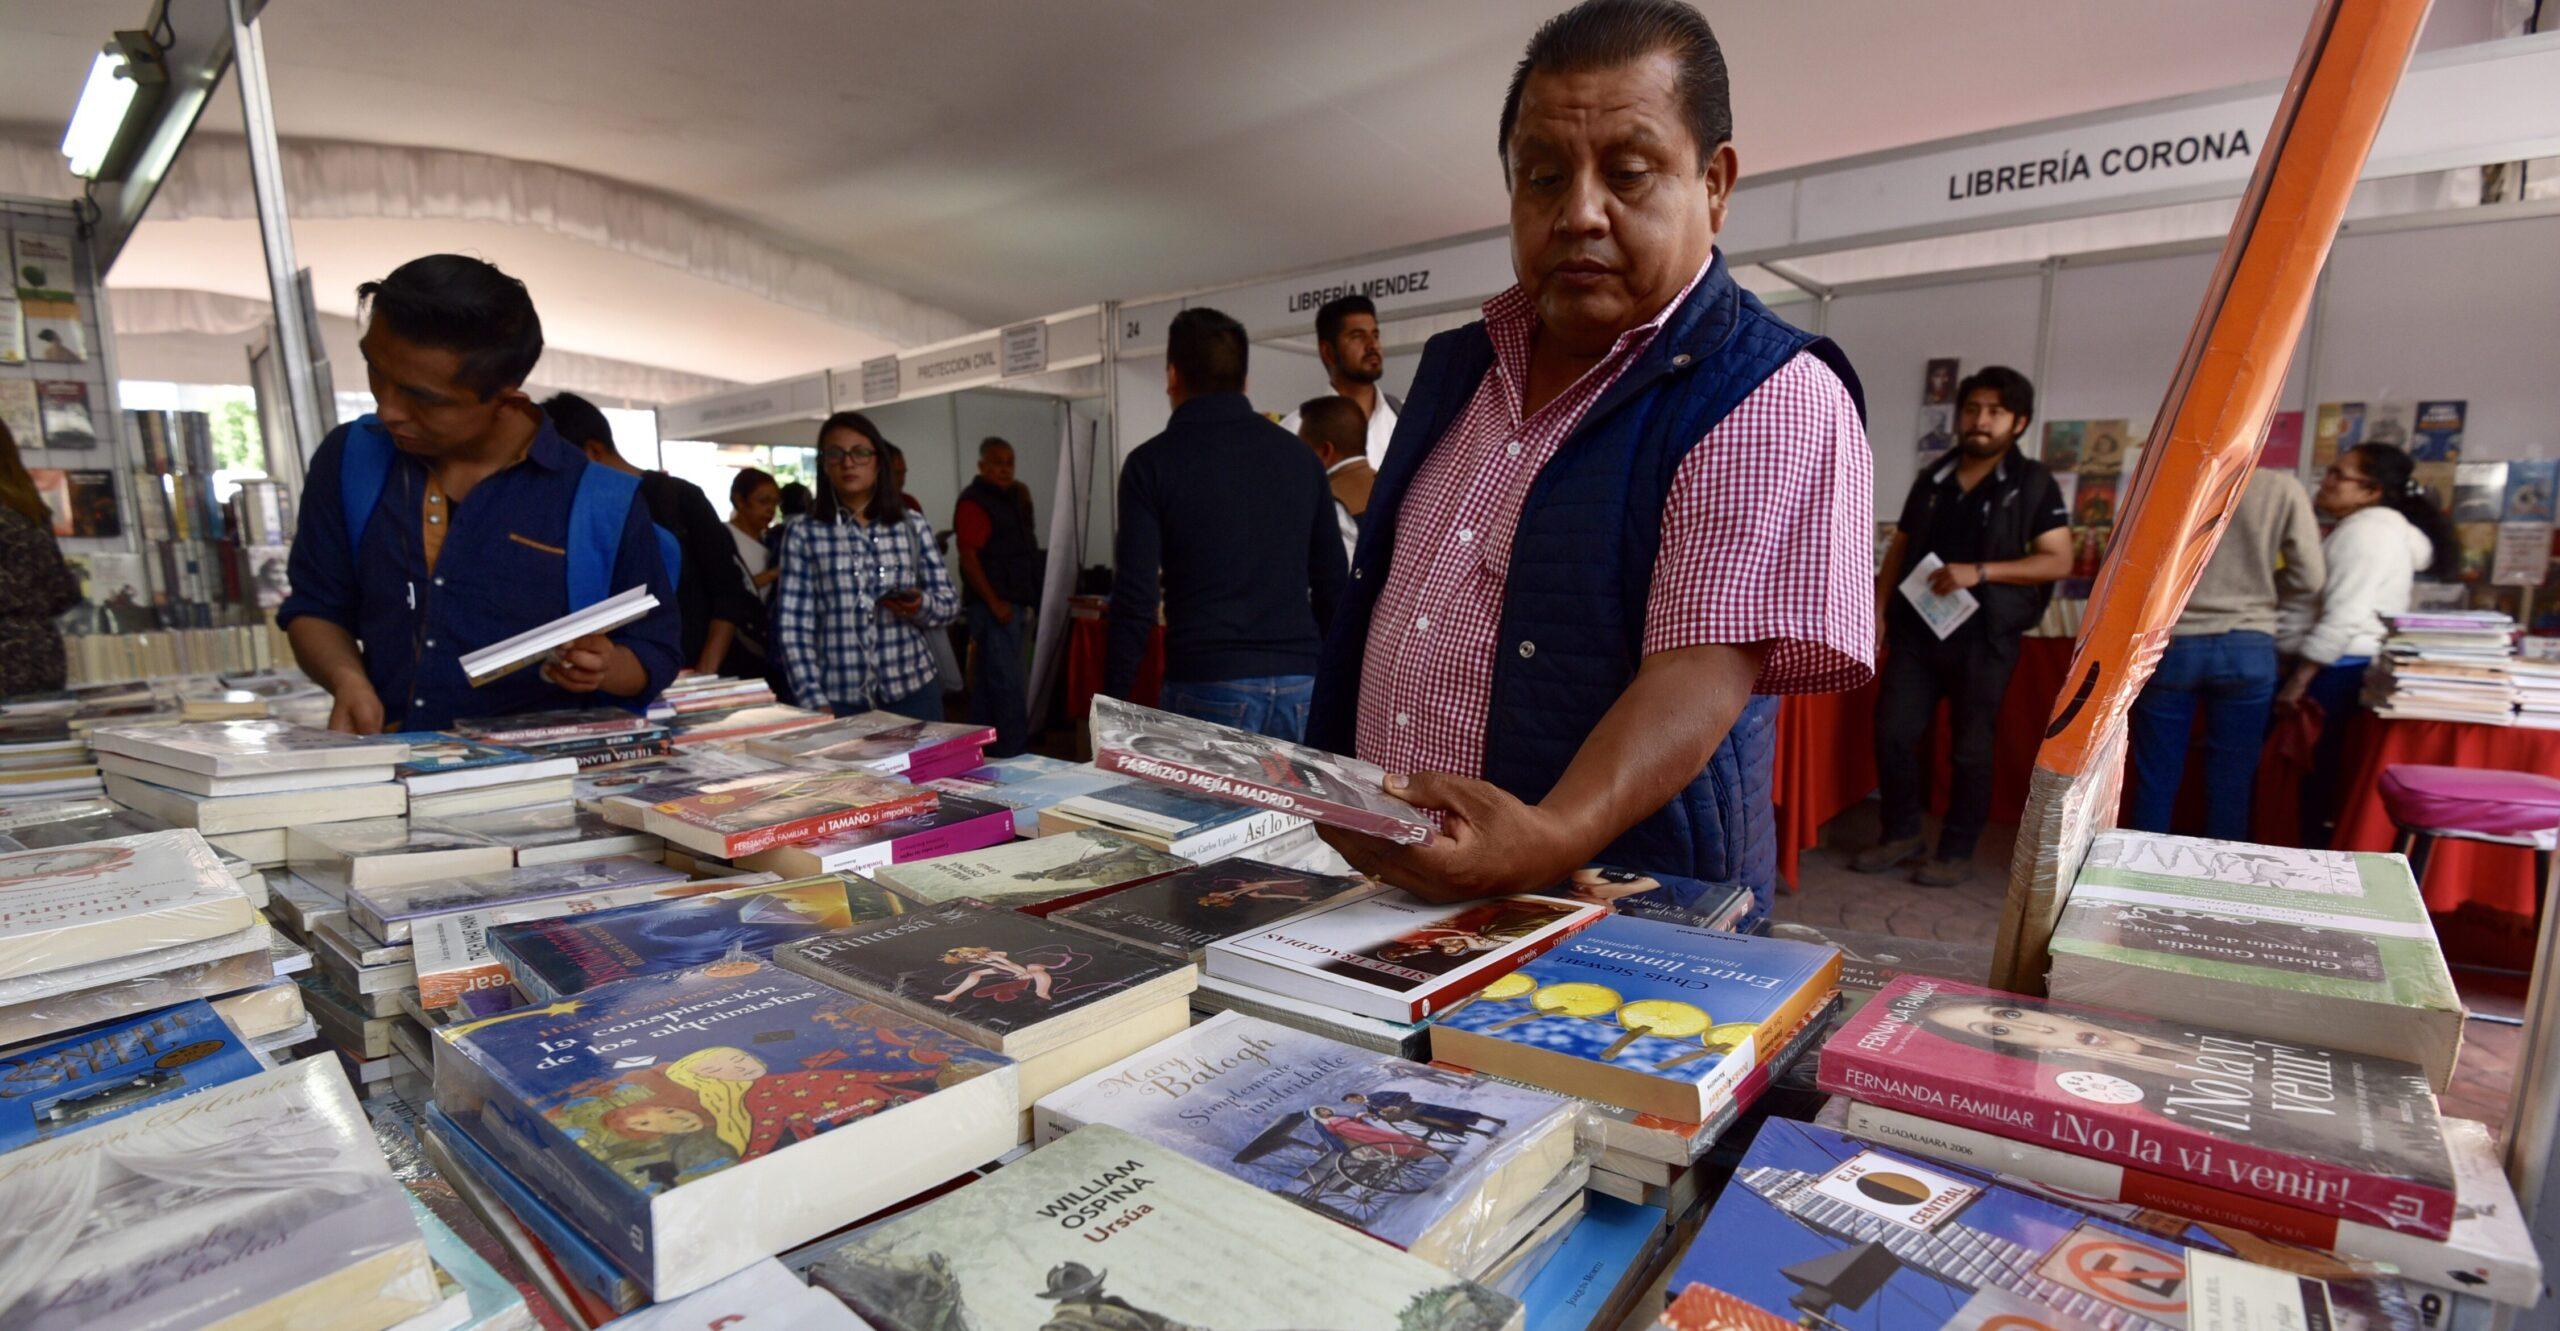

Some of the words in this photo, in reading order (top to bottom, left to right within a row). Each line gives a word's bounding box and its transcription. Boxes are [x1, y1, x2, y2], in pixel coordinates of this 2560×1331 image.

[1949, 149, 2091, 200] LIBRERÍA
[2102, 129, 2250, 177] CORONA
[1361, 270, 1430, 300] MENDEZ
[1127, 320, 1140, 339] 24
[577, 753, 611, 767] BLANC
[1188, 773, 1232, 793] MEJÍA
[1232, 784, 1295, 809] MADRID
[732, 833, 777, 854] FERNANDA
[777, 827, 811, 845] FAMILIAR
[817, 820, 826, 834] el
[828, 811, 871, 832] TAMAÑO
[1244, 819, 1267, 844] Así
[1269, 813, 1283, 834] lo
[799, 917, 937, 961] Princesa
[1262, 932, 1361, 970] TRAGEDIAS
[2158, 938, 2255, 960] Guardia
[2214, 935, 2240, 946] de
[2315, 947, 2341, 959] El
[1364, 959, 1431, 982] SIETE
[1554, 956, 1639, 979] Stewart
[1569, 943, 1686, 977] limones
[1692, 964, 1785, 991] Entre
[2262, 952, 2343, 971] Gloria
[1644, 971, 1710, 992] Chris
[536, 1054, 577, 1071] de
[584, 1036, 639, 1056] los
[648, 990, 818, 1039] alquimistas
[592, 984, 780, 1040] conspiración
[1857, 1008, 1915, 1052] FERNANDA
[1896, 981, 1940, 1010] FAMILIAR
[1096, 1055, 1192, 1099] Mary
[1144, 1032, 1277, 1101] Balogh
[1242, 1053, 1349, 1115] inolvidable
[2175, 1055, 2254, 1084] la
[2253, 1040, 2337, 1116] venir!
[1178, 1061, 1294, 1130] Simplemente
[1844, 1068, 1945, 1106] FERNANDA
[1949, 1094, 2035, 1130] FAMILIAR
[2051, 1109, 2116, 1153] ¡No
[2128, 1128, 2164, 1166] la
[2176, 1142, 2213, 1176] vi
[2226, 1162, 2352, 1209] venir!
[1879, 1124, 1948, 1150] GUADALAJARA
[1949, 1142, 1973, 1156] 2006
[1036, 1159, 1145, 1221] WILLIAM
[1836, 1164, 1866, 1184] EJE
[1060, 1177, 1155, 1230] OSPINA
[1909, 1184, 1968, 1226] CENTRAL
[1083, 1202, 1155, 1244] Ursúa
